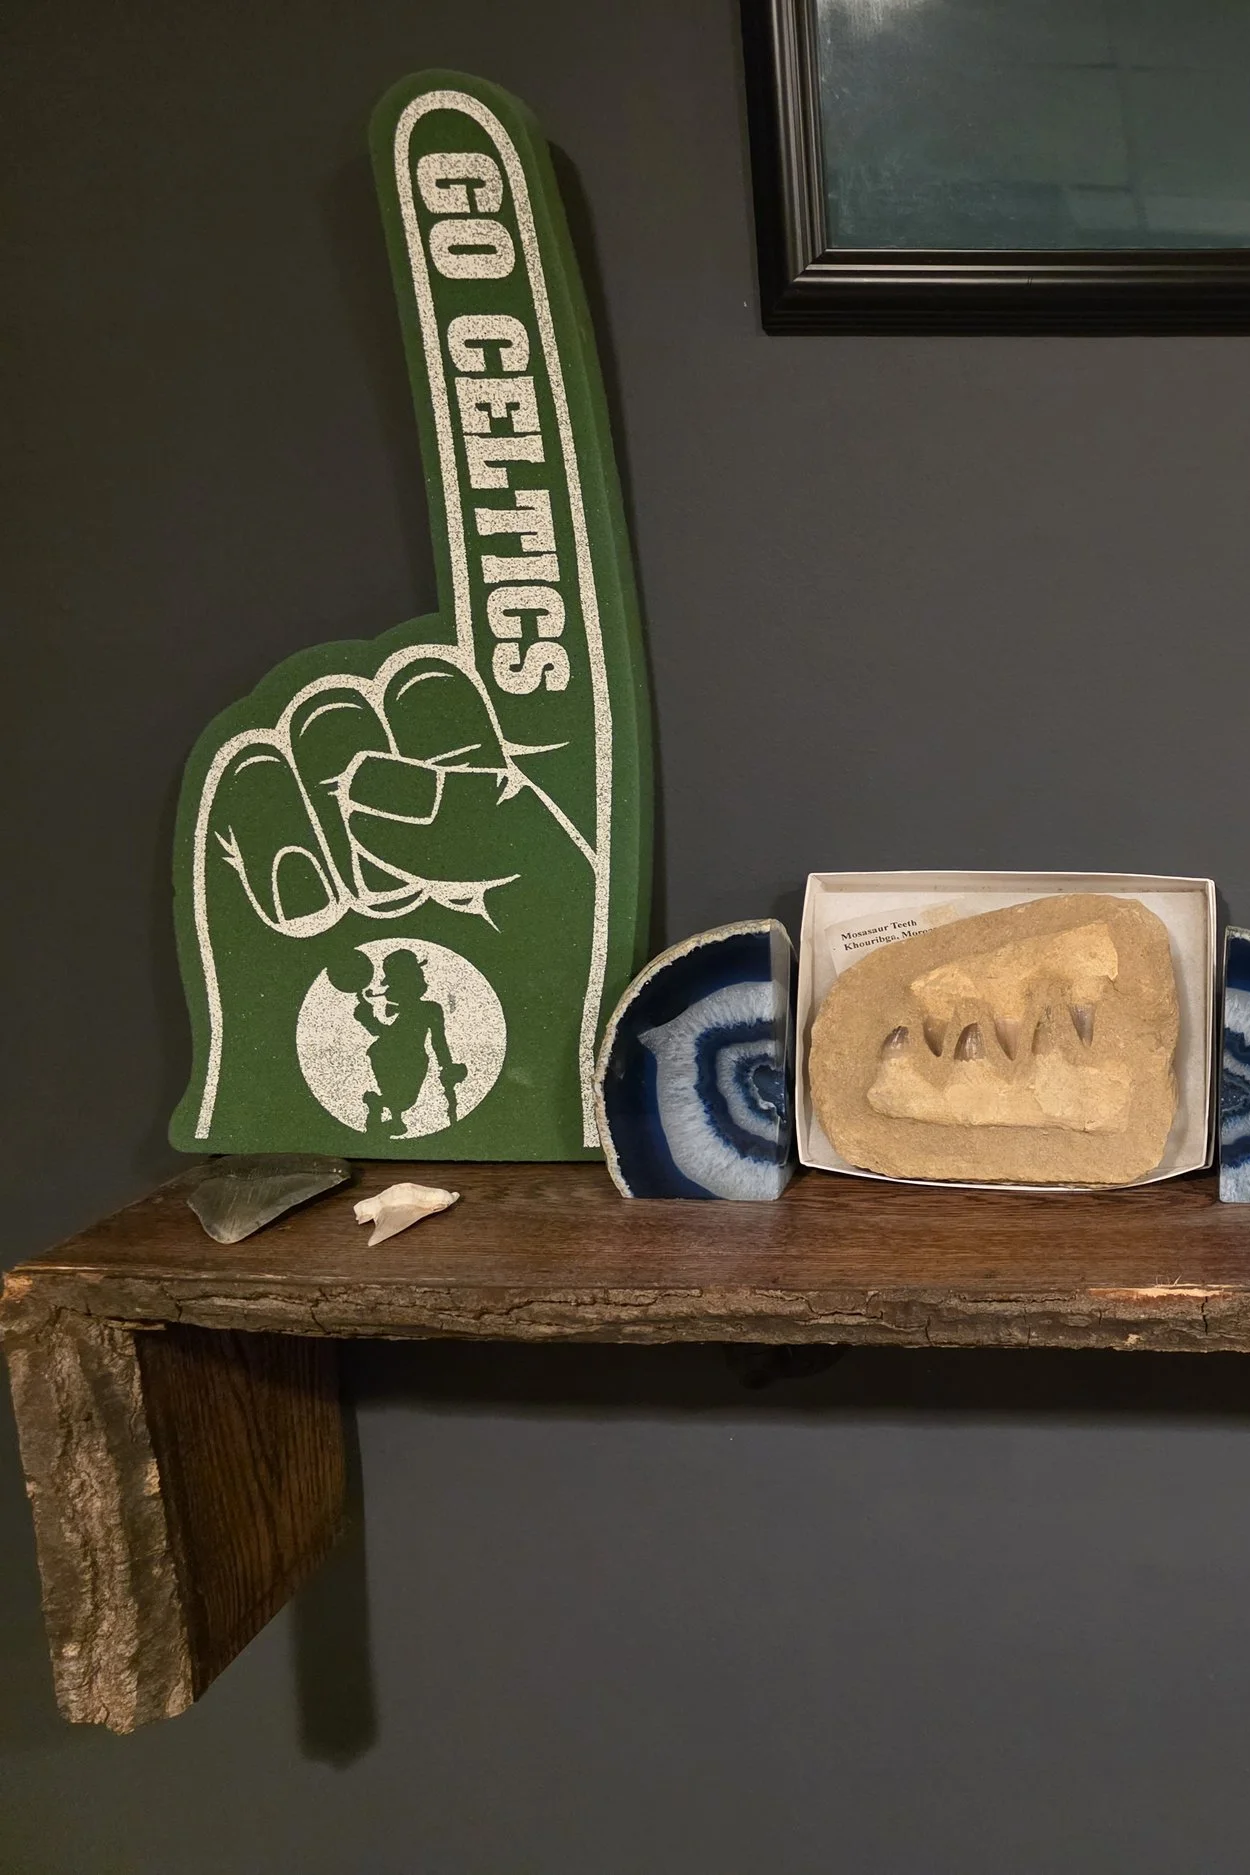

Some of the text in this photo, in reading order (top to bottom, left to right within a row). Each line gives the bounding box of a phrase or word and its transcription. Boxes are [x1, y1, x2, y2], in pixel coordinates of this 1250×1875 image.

[416, 152, 569, 694] GO CELTICS
[841, 919, 917, 941] Mosasaur Teeth
[844, 935, 900, 951] Khouribga,
